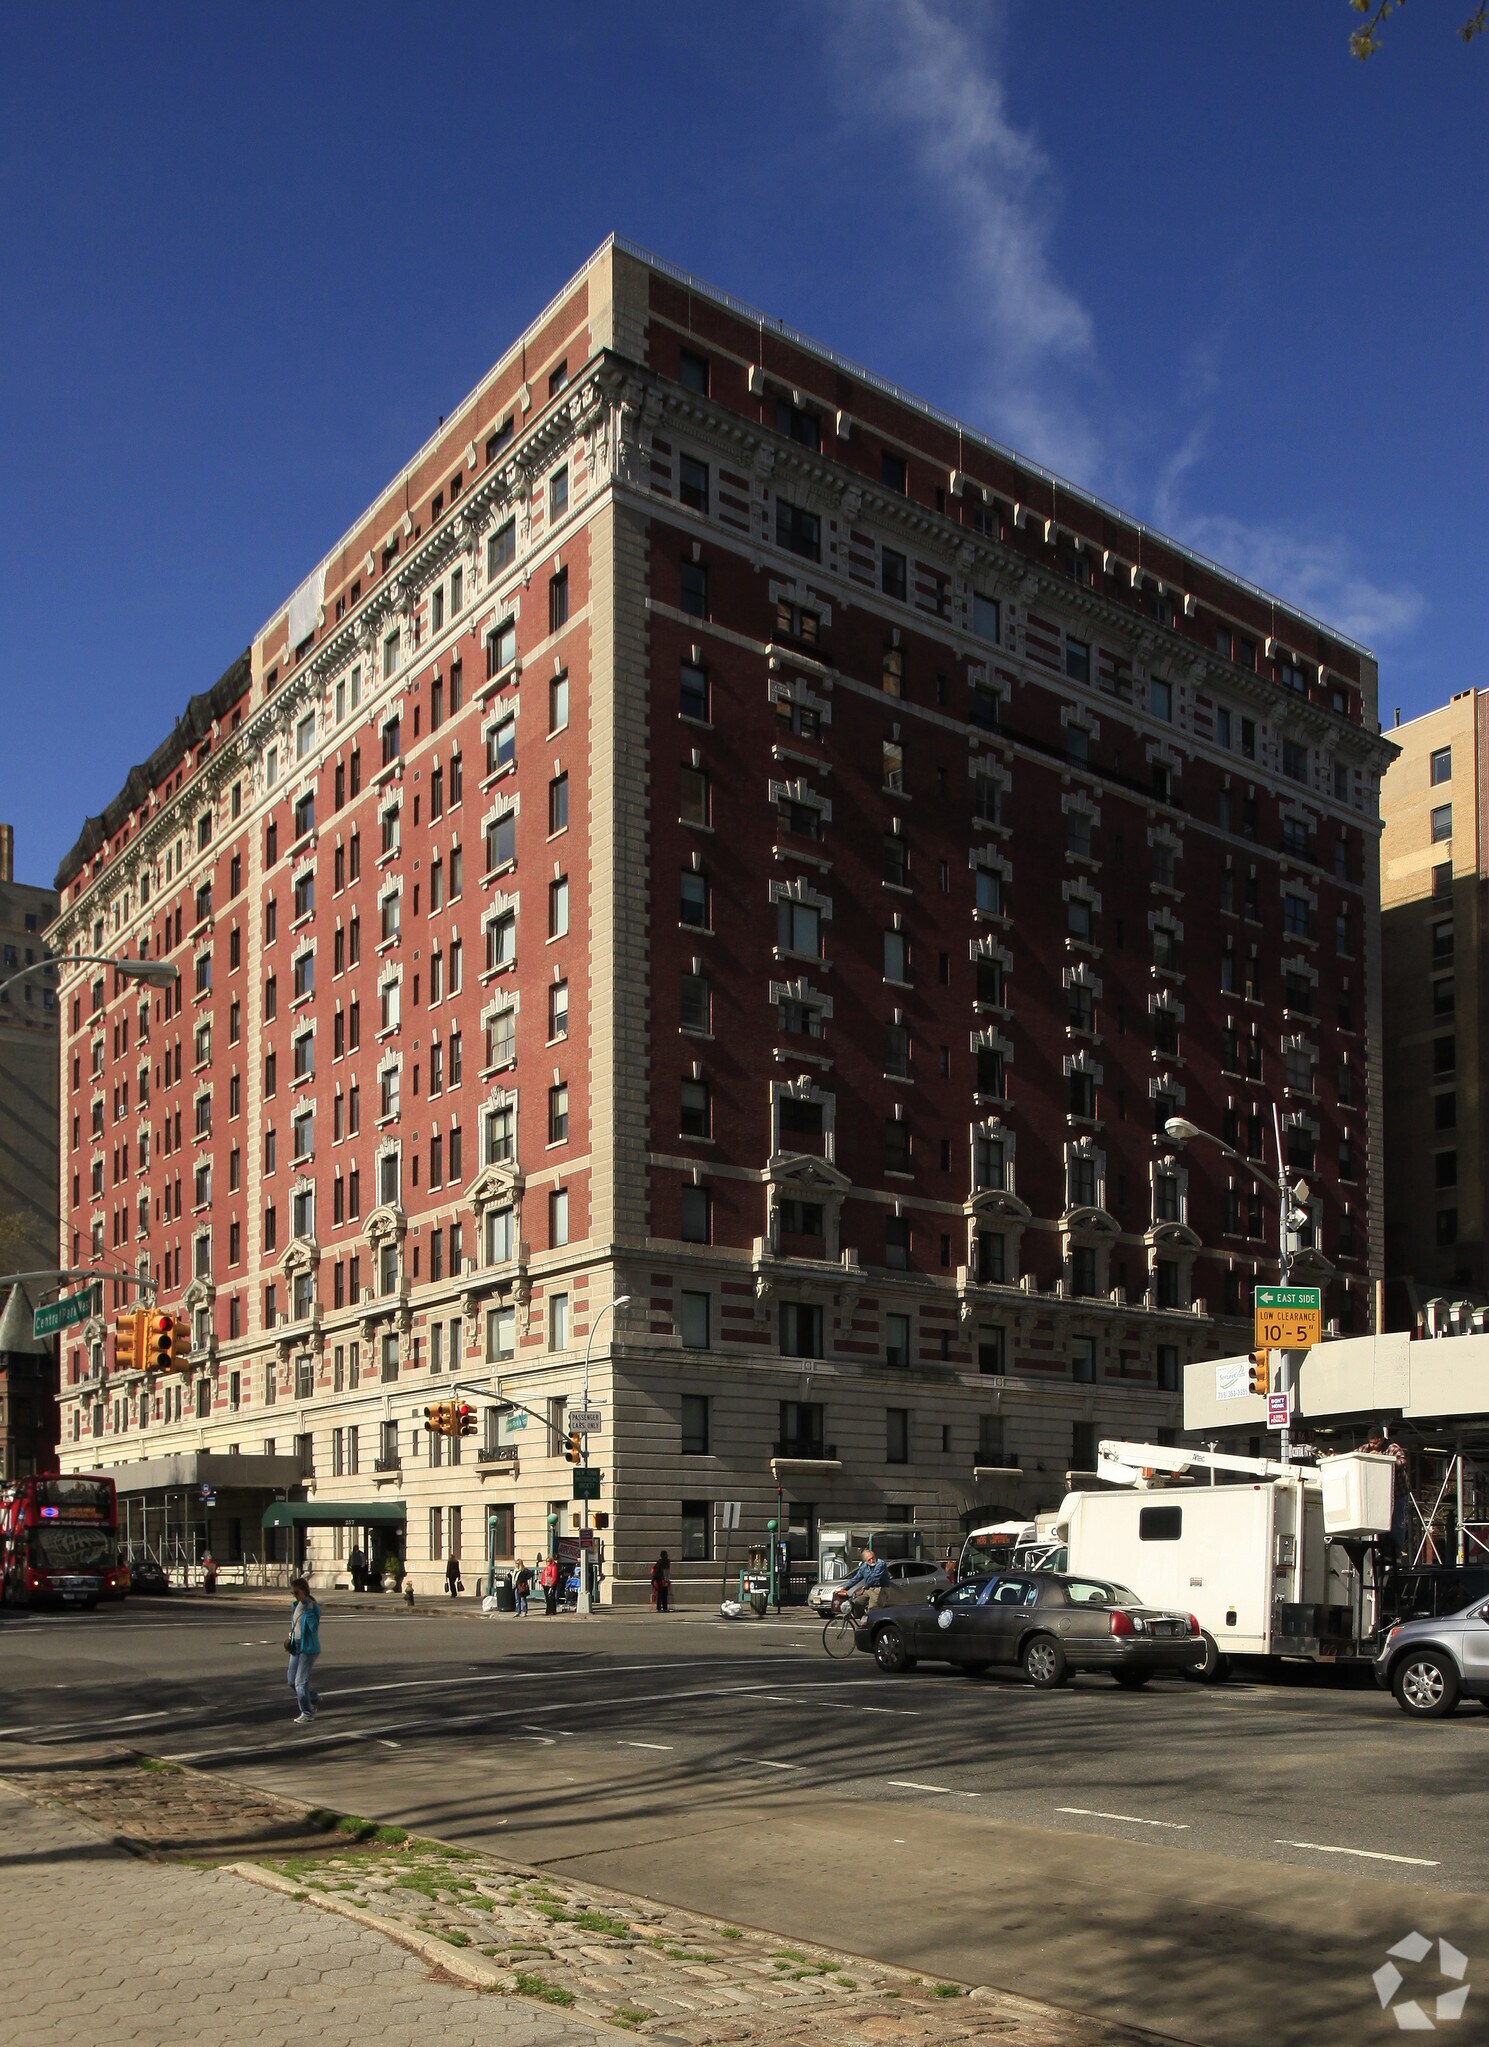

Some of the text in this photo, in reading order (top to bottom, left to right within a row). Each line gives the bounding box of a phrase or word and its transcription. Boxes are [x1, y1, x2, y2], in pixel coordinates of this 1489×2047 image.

[1277, 1294, 1315, 1304] EAST SIDE
[35, 1310, 61, 1330] Central
[1260, 1311, 1316, 1322] LOW CLEARANCE
